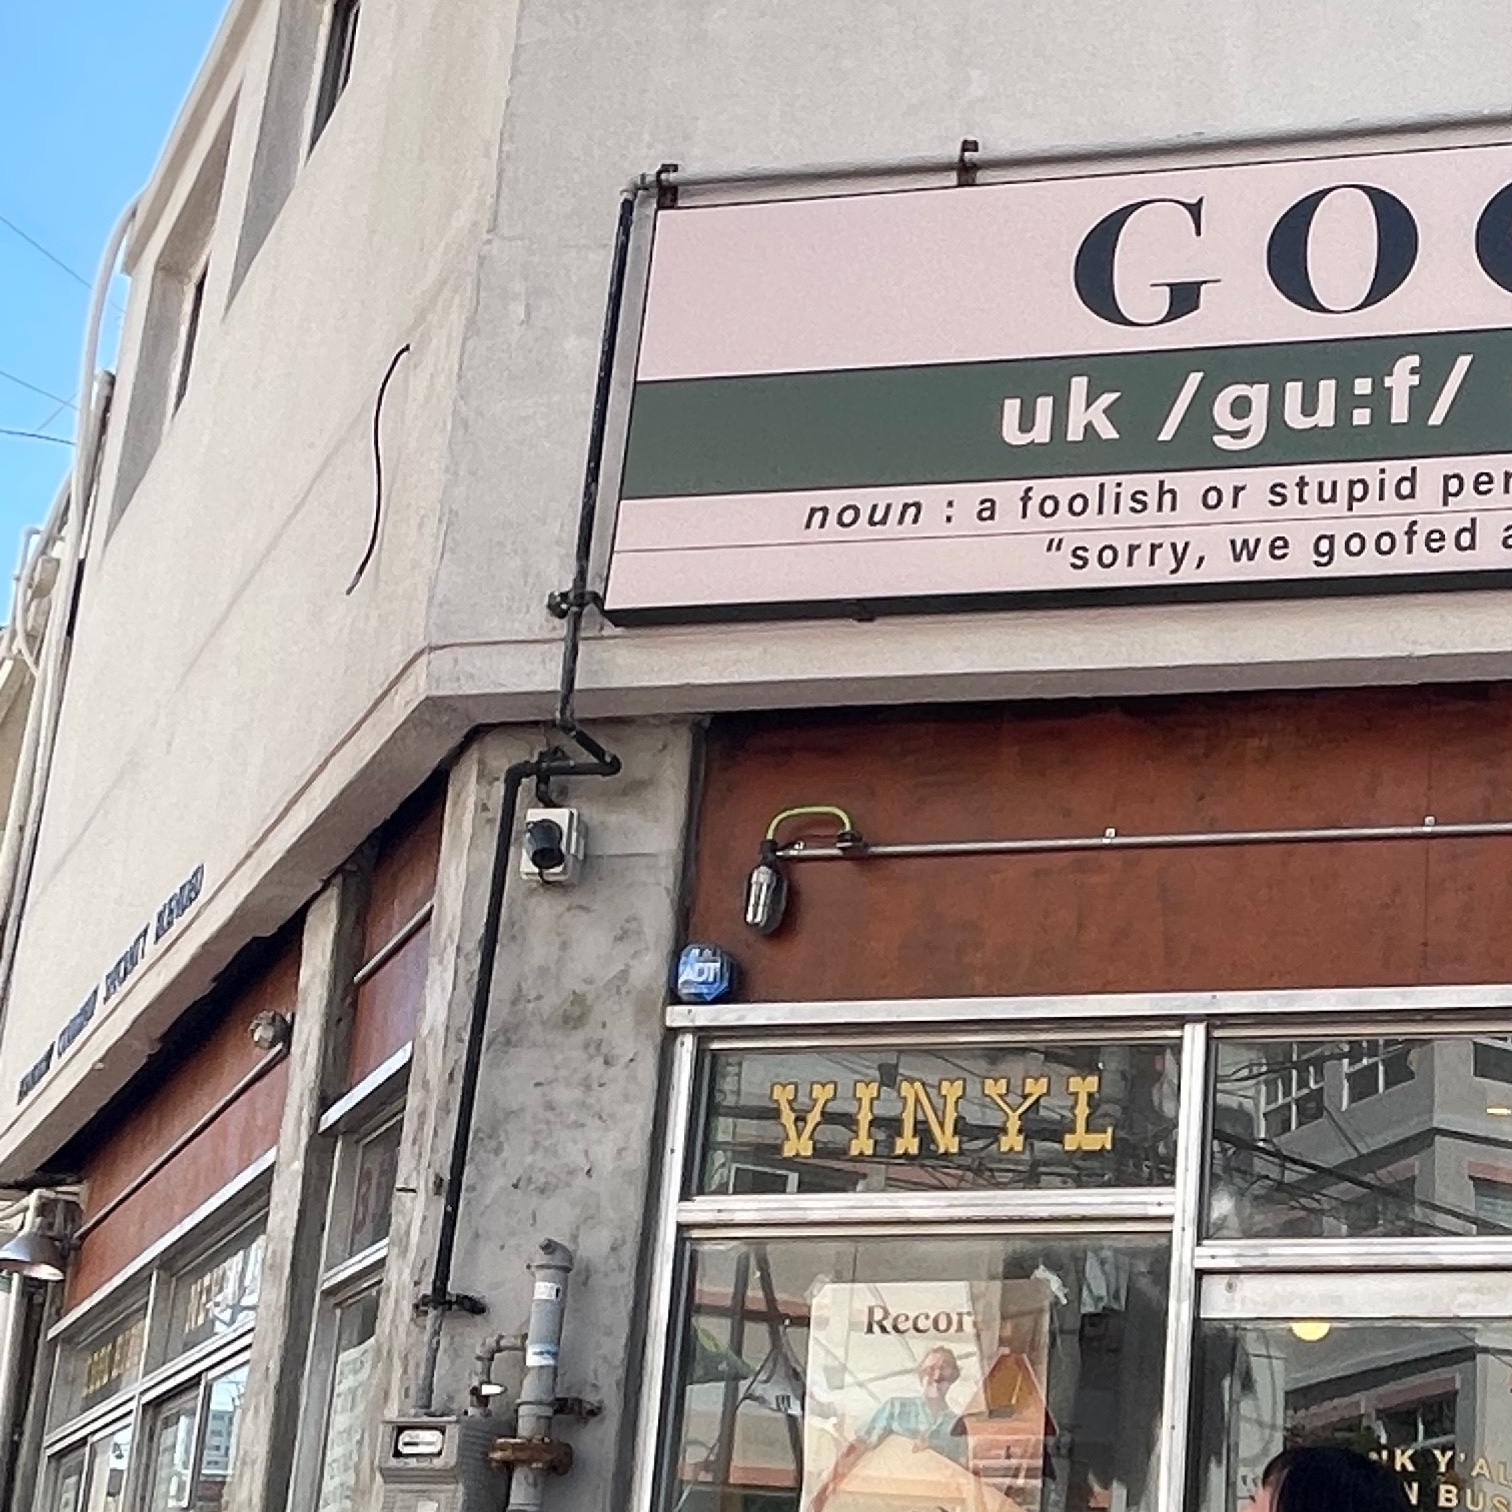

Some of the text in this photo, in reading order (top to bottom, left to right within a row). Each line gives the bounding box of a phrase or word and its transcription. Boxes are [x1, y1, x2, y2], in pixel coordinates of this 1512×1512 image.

[1001, 376, 1121, 446] uk
[1157, 355, 1475, 451] /gu:f/
[804, 501, 922, 530] noun
[976, 498, 997, 522] a
[1019, 479, 1178, 521] foolish
[1202, 484, 1247, 510] or
[1268, 466, 1418, 514] stupid
[1230, 536, 1291, 564] we
[1313, 517, 1478, 568] goofed
[770, 1075, 1115, 1158] VINYL
